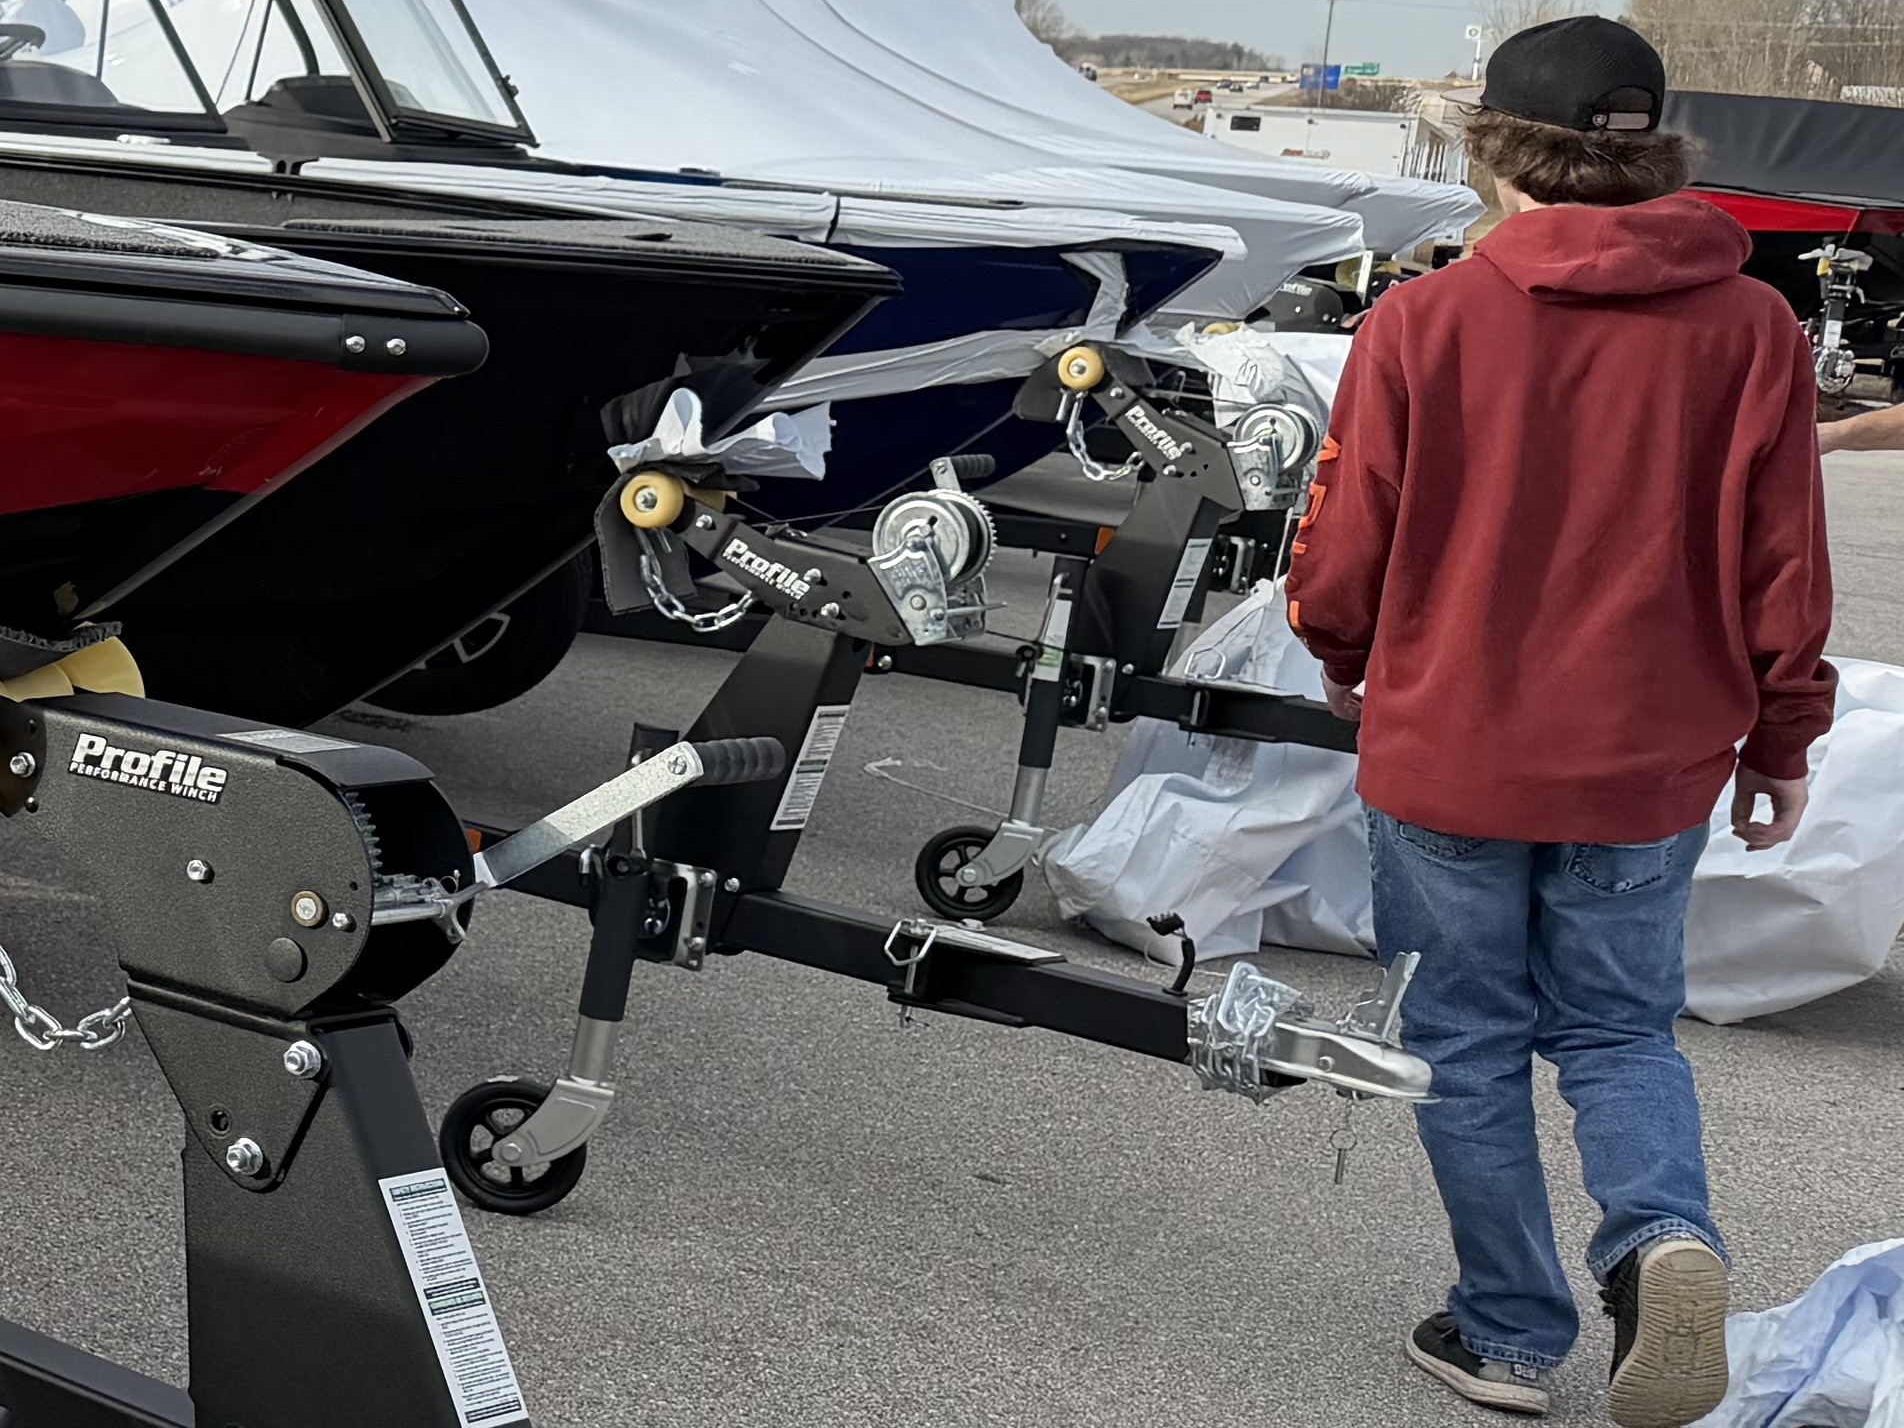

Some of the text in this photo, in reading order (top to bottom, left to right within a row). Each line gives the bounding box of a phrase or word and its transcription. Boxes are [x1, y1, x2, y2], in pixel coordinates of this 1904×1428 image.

[724, 538, 810, 594] Profile
[69, 761, 218, 803] PERFORMANCE WINCH
[72, 733, 227, 792] Profile
